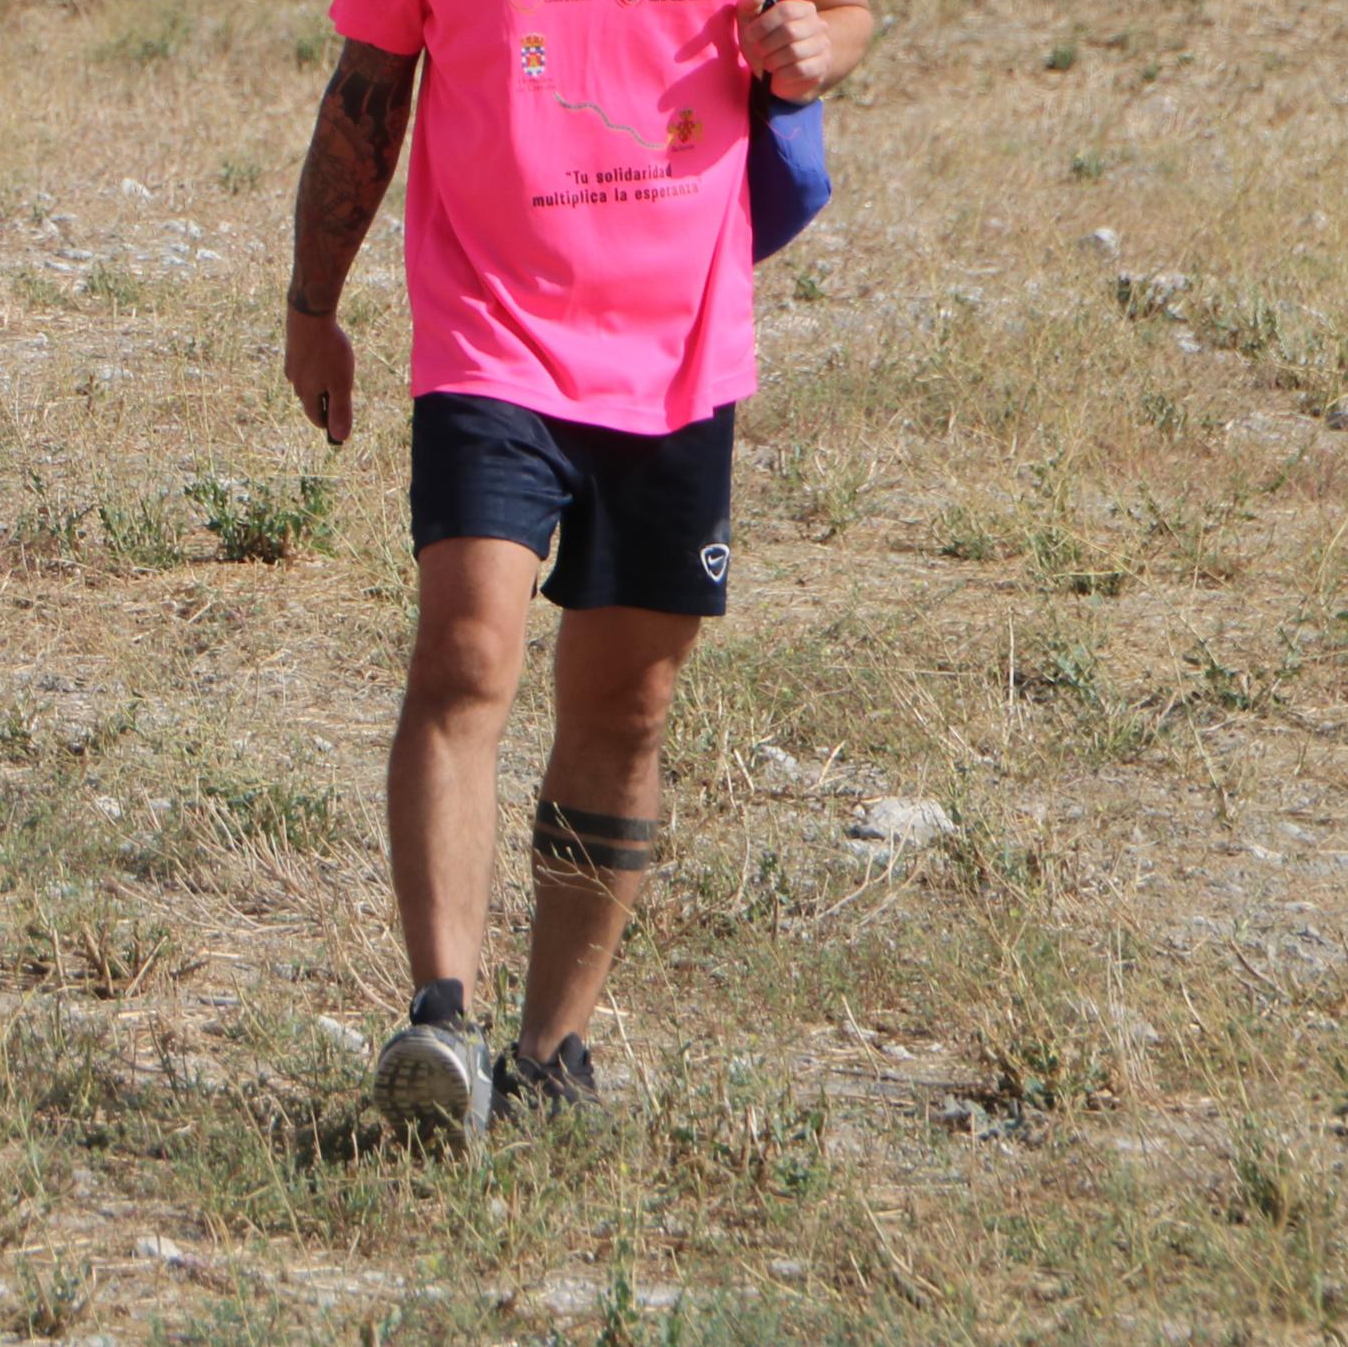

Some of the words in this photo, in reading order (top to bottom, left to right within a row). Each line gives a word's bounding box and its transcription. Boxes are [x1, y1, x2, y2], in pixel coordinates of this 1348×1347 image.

[596, 163, 673, 184] solidaridad
[532, 187, 607, 209] multiplica
[614, 188, 628, 201] la
